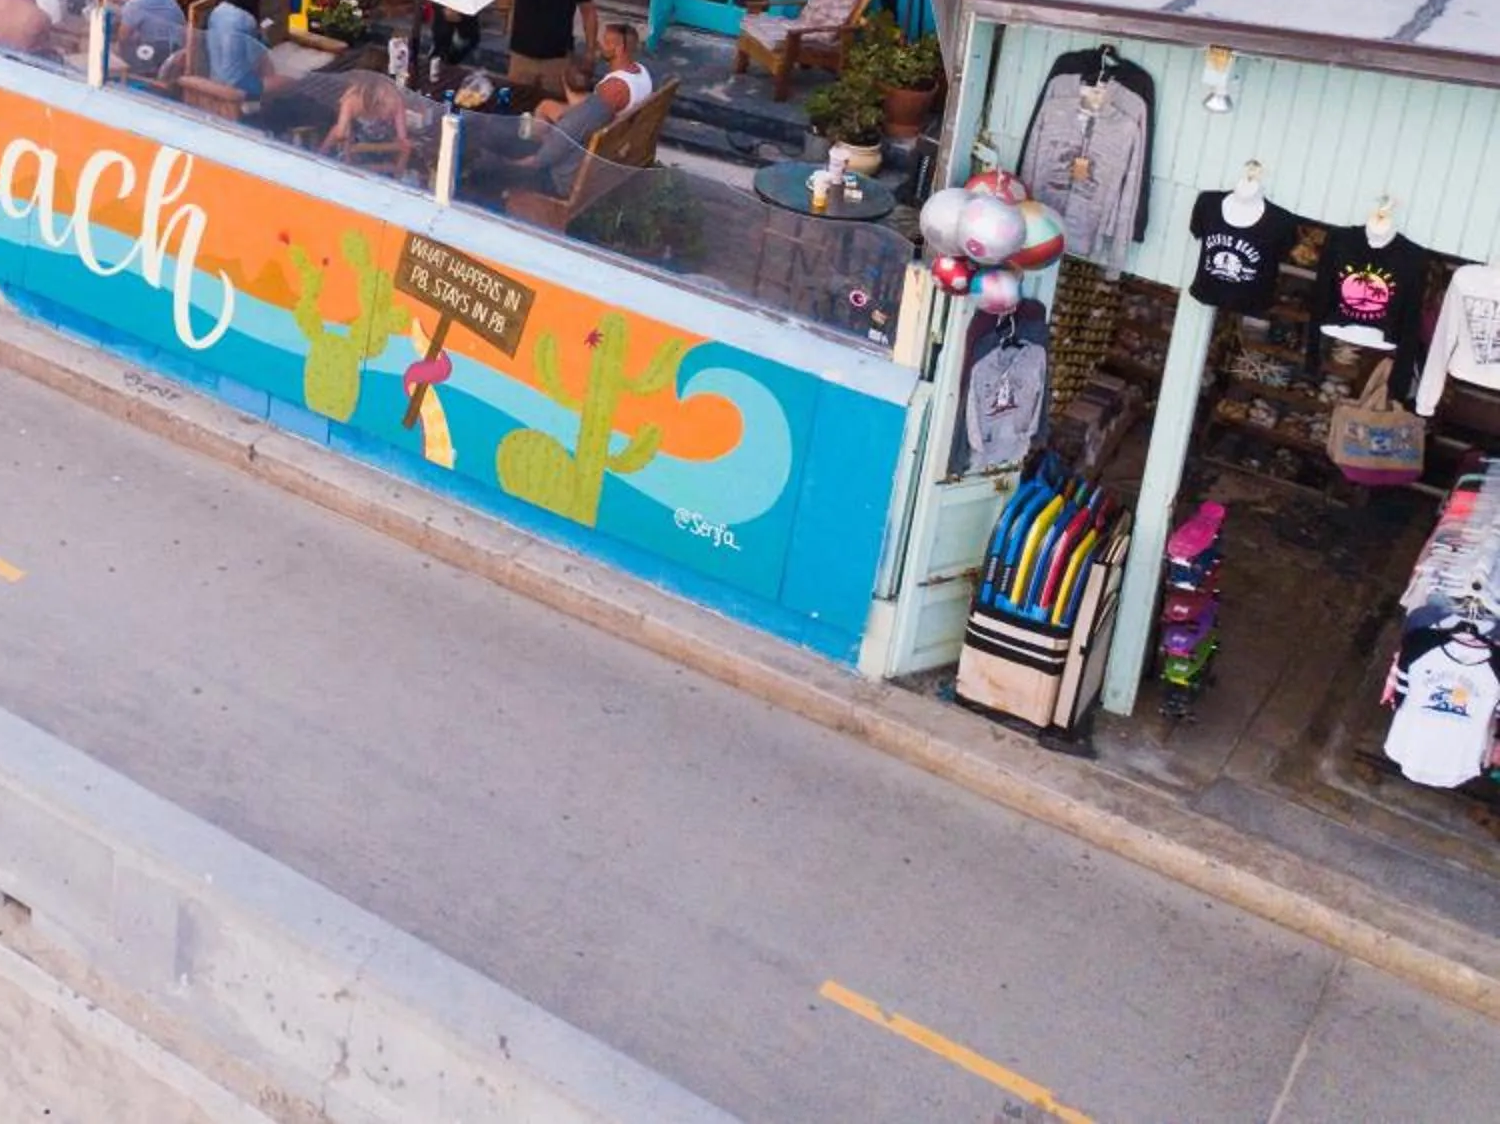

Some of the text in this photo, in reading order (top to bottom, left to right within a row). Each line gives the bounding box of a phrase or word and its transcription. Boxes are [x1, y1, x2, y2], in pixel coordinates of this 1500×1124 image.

[410, 236, 522, 313] WHAT HAPPENS IN
[431, 277, 472, 314] STAYS
[471, 300, 489, 324] IN
[487, 309, 507, 334] PB
